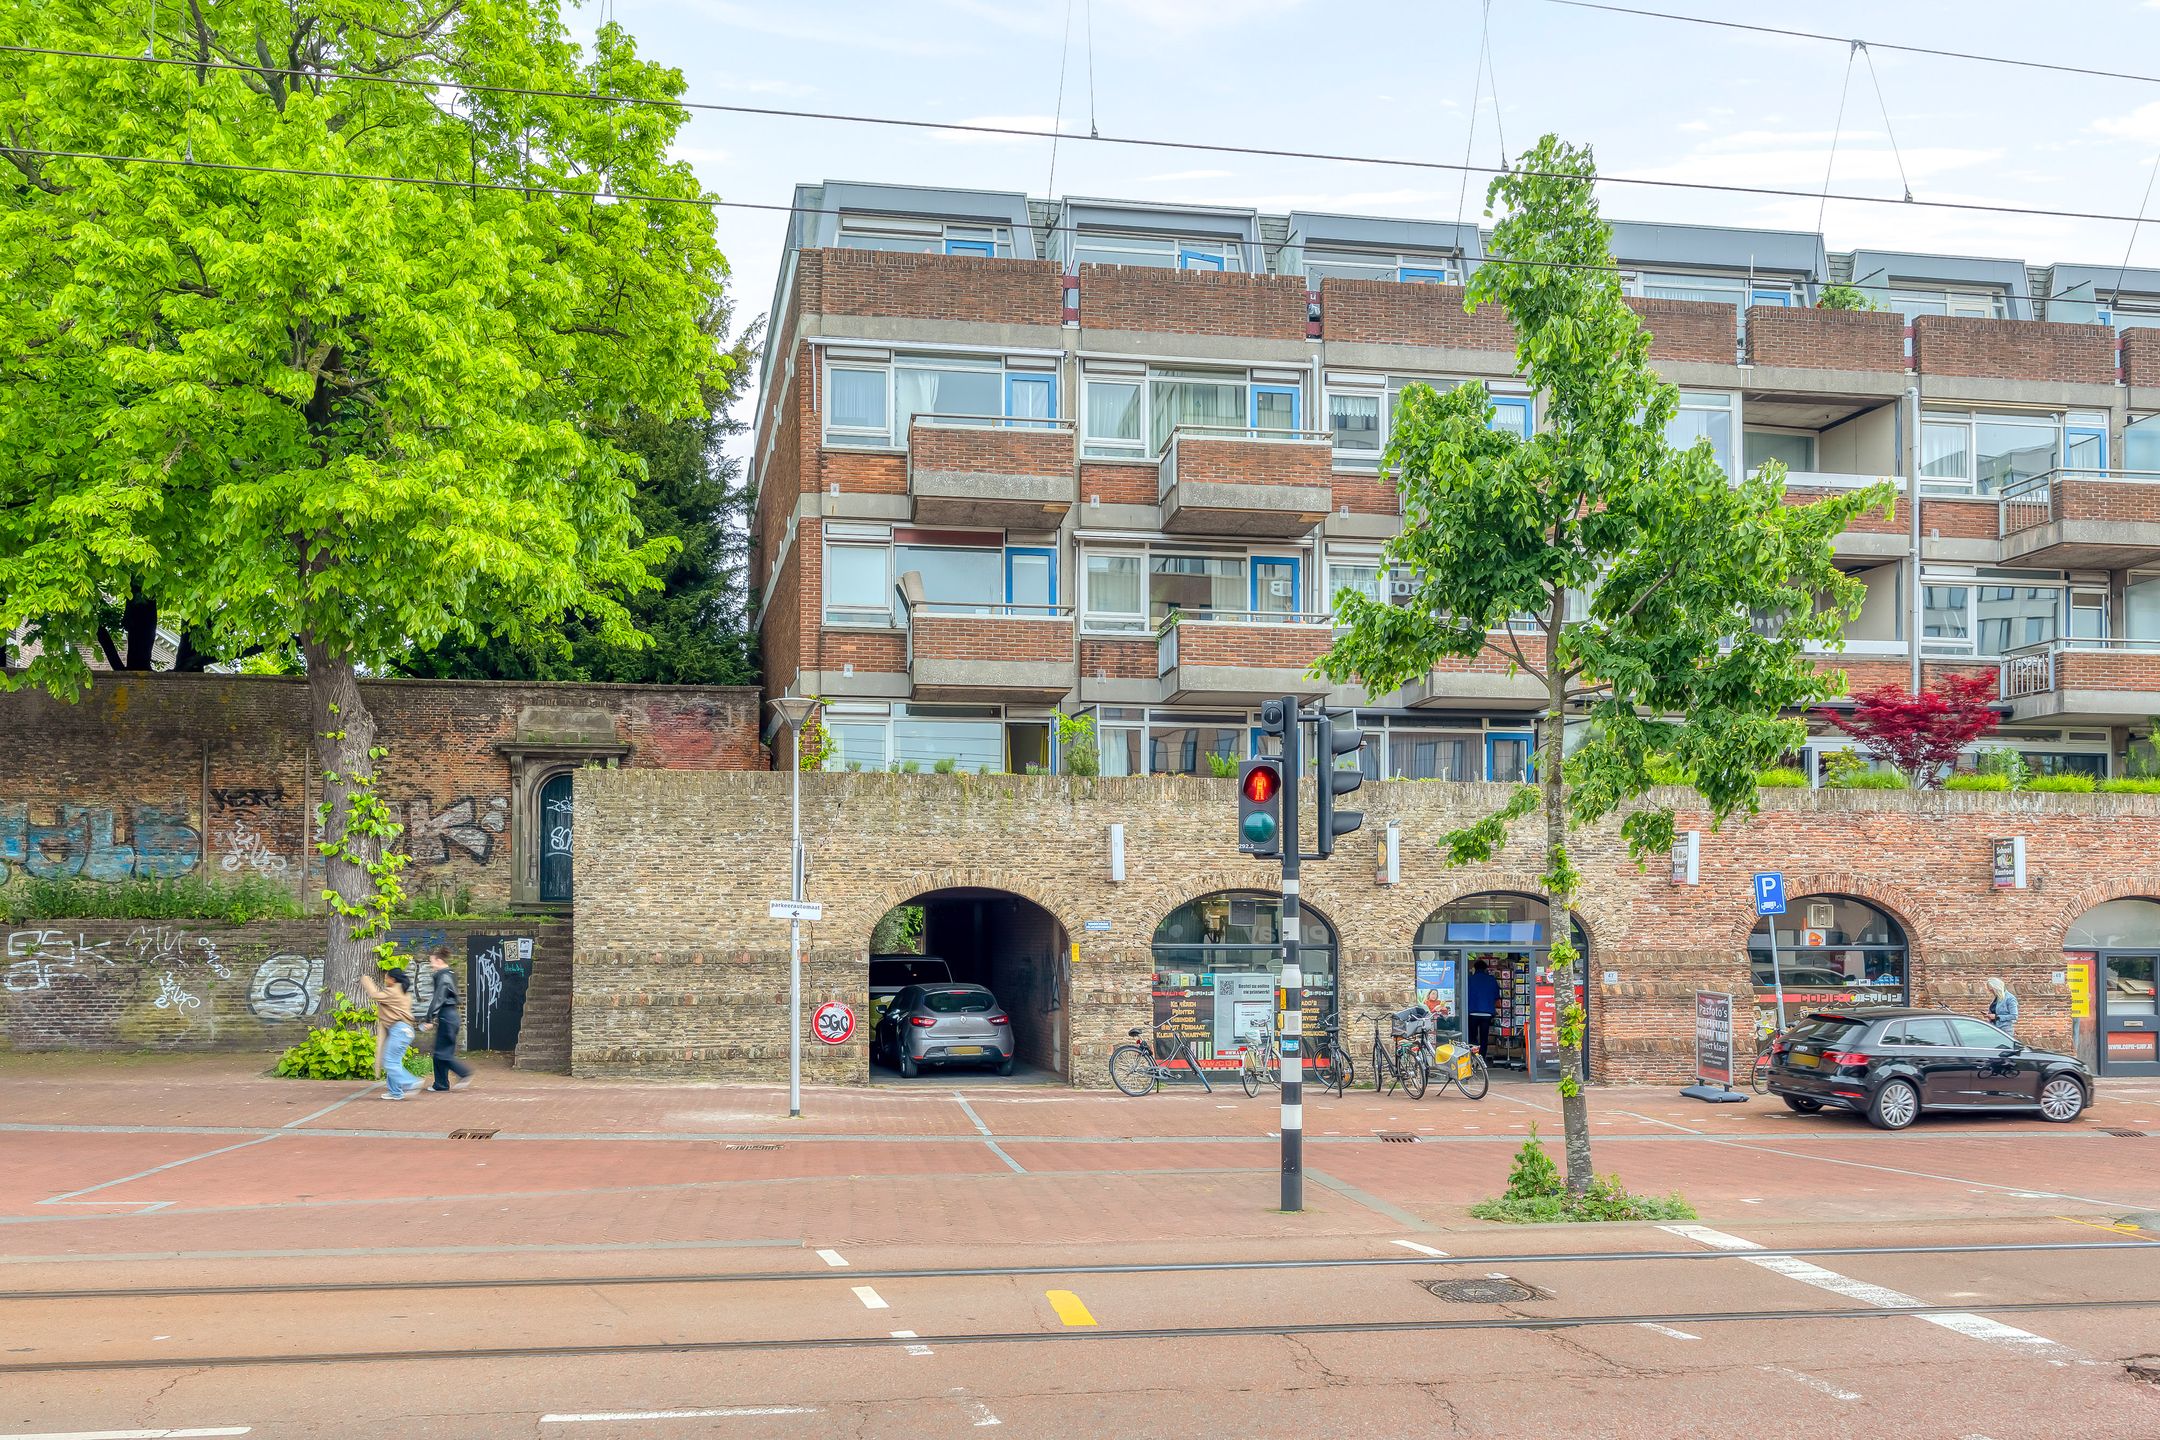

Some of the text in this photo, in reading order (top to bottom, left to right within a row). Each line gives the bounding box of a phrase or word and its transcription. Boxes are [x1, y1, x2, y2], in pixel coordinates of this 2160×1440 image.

[1761, 877, 1777, 898] P
[771, 902, 820, 911] parkeerautomaat
[1699, 1004, 1728, 1018] Pasfoto's
[1713, 1042, 1728, 1053] klaar
